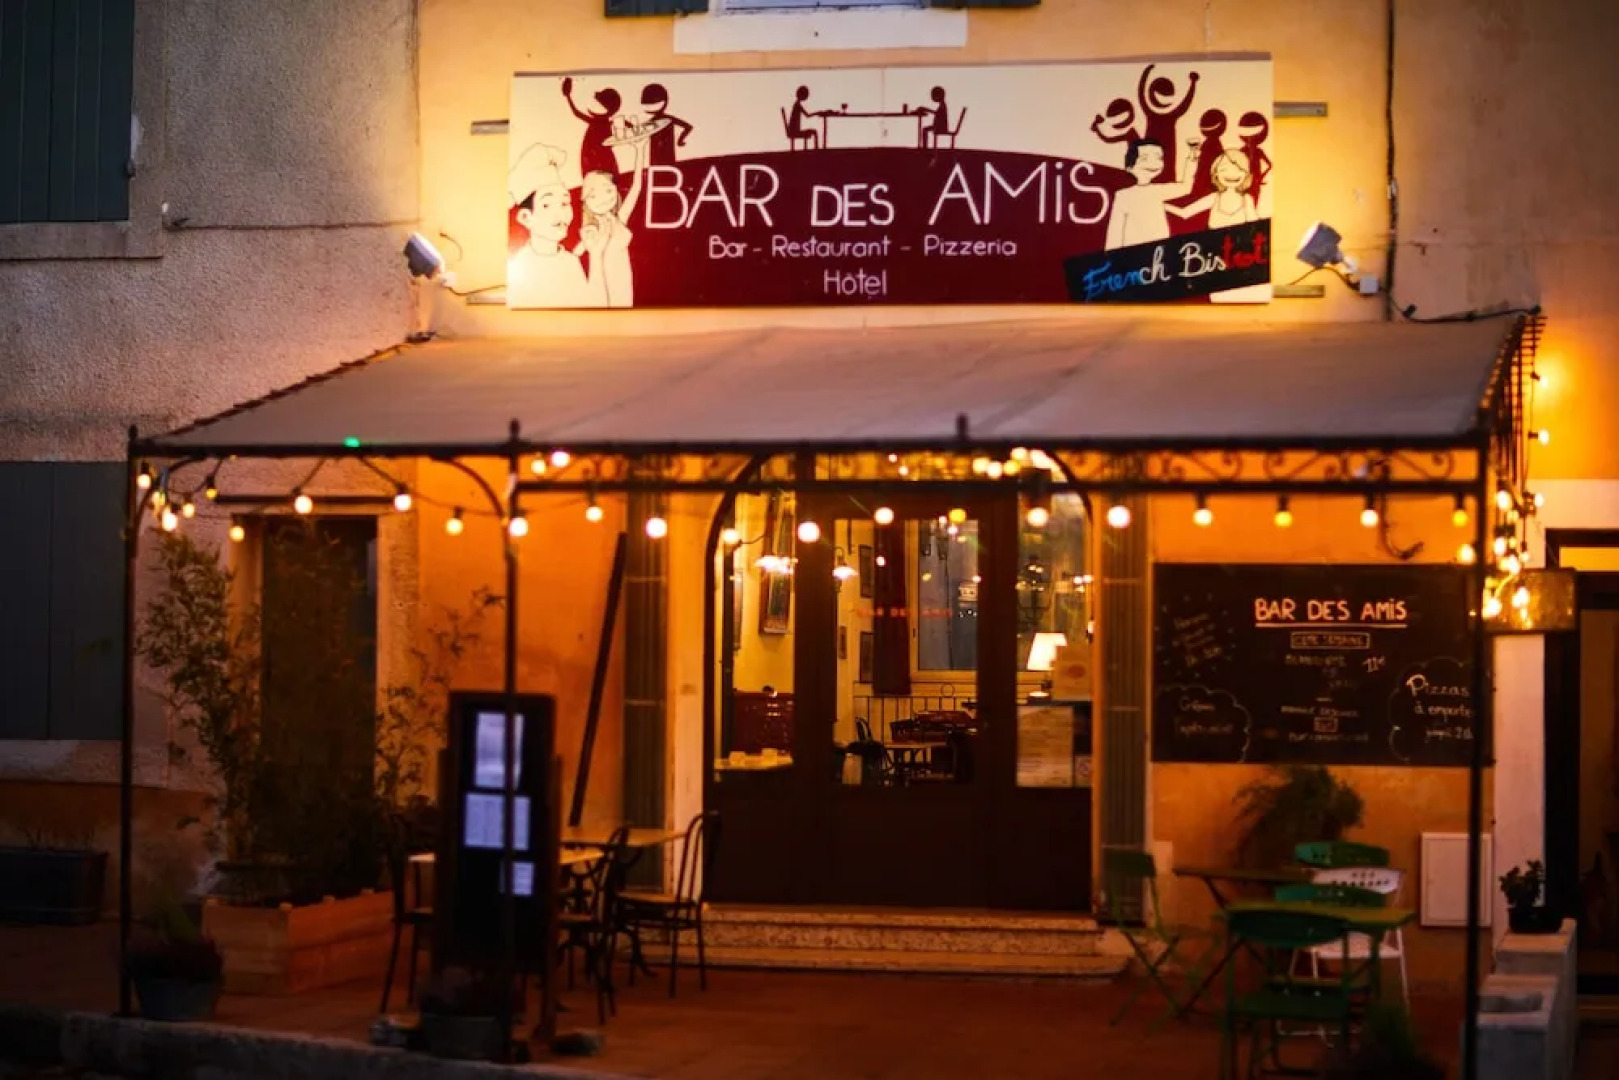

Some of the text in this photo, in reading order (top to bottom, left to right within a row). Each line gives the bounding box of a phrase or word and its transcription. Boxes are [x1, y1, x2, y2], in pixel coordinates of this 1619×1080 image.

[645, 164, 780, 229] BAR
[810, 183, 895, 227] DES
[708, 234, 748, 259] Bar
[771, 234, 892, 258] Restaurant
[924, 234, 1017, 256] Pizzeria
[1082, 245, 1171, 301] French
[1255, 598, 1296, 620] BAR
[1307, 600, 1351, 620] DES
[1405, 673, 1470, 697] Pizzas
